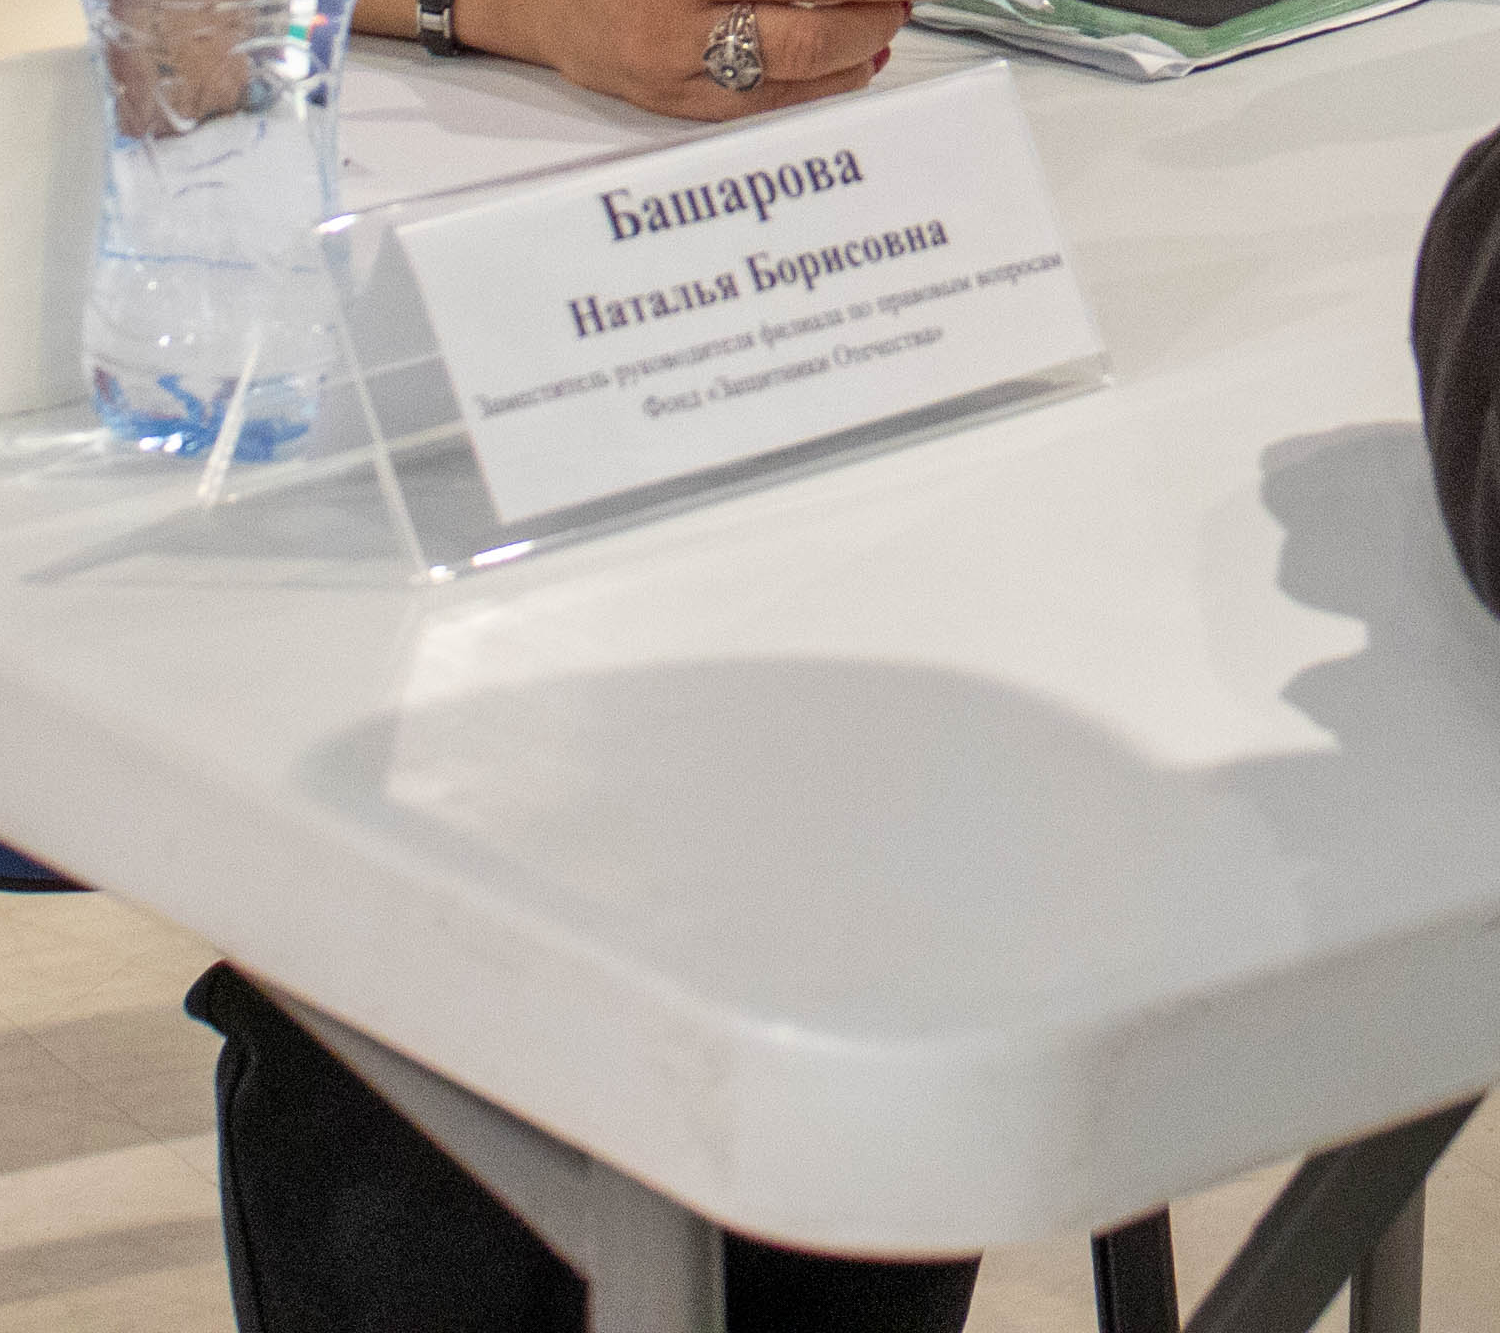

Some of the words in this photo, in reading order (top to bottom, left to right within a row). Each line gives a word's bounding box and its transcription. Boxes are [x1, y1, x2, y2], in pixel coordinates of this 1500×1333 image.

[599, 148, 864, 242] Башарова
[566, 271, 740, 339] Наталья
[744, 219, 949, 293] Борисовна
